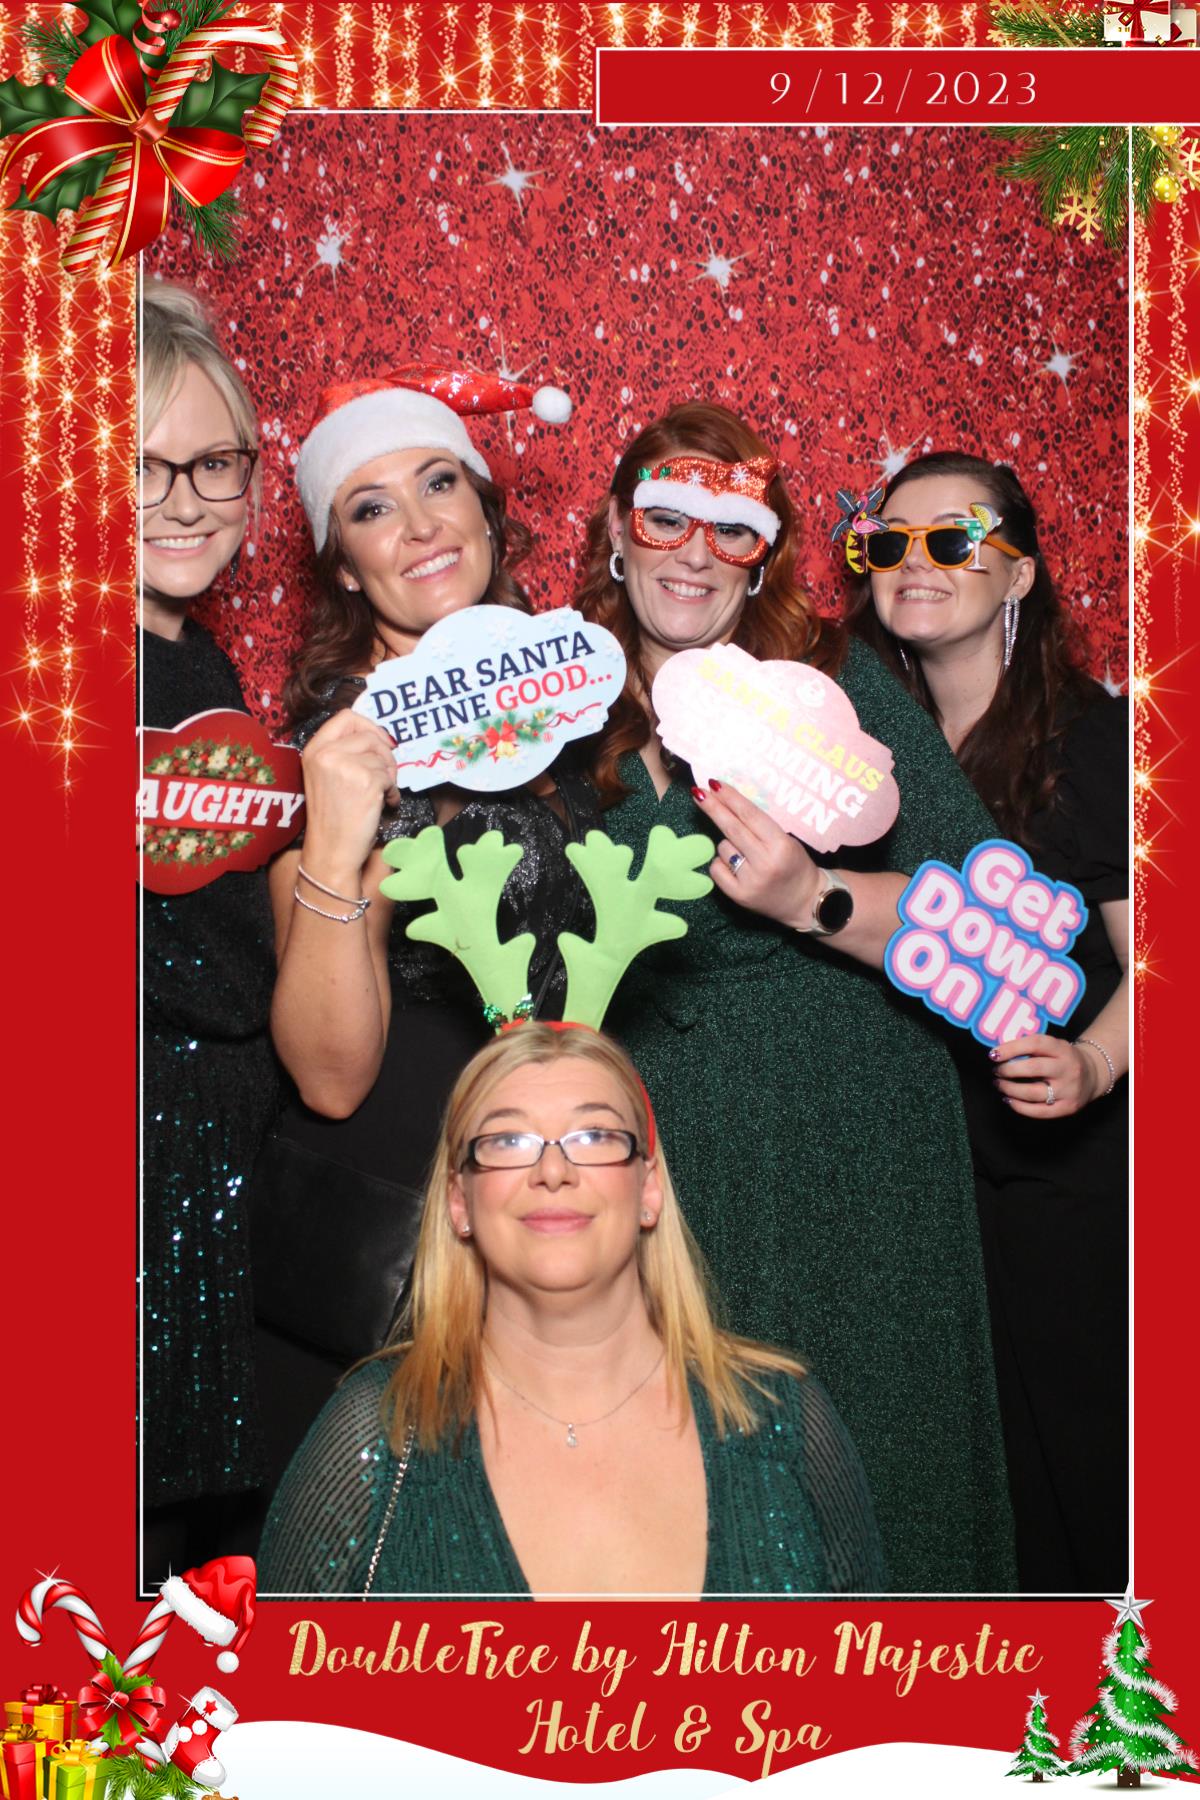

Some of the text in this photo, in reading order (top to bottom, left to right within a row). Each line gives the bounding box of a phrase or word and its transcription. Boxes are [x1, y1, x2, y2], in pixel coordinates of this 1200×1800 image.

[370, 631, 595, 719] DEAR SANTA
[496, 664, 612, 712] GOOD...
[752, 724, 868, 818] OMING
[753, 764, 840, 835] OWN
[795, 722, 885, 792] CLAUS
[906, 868, 1079, 1018] Down
[970, 848, 1081, 949] Get
[892, 929, 1040, 1045] On It
